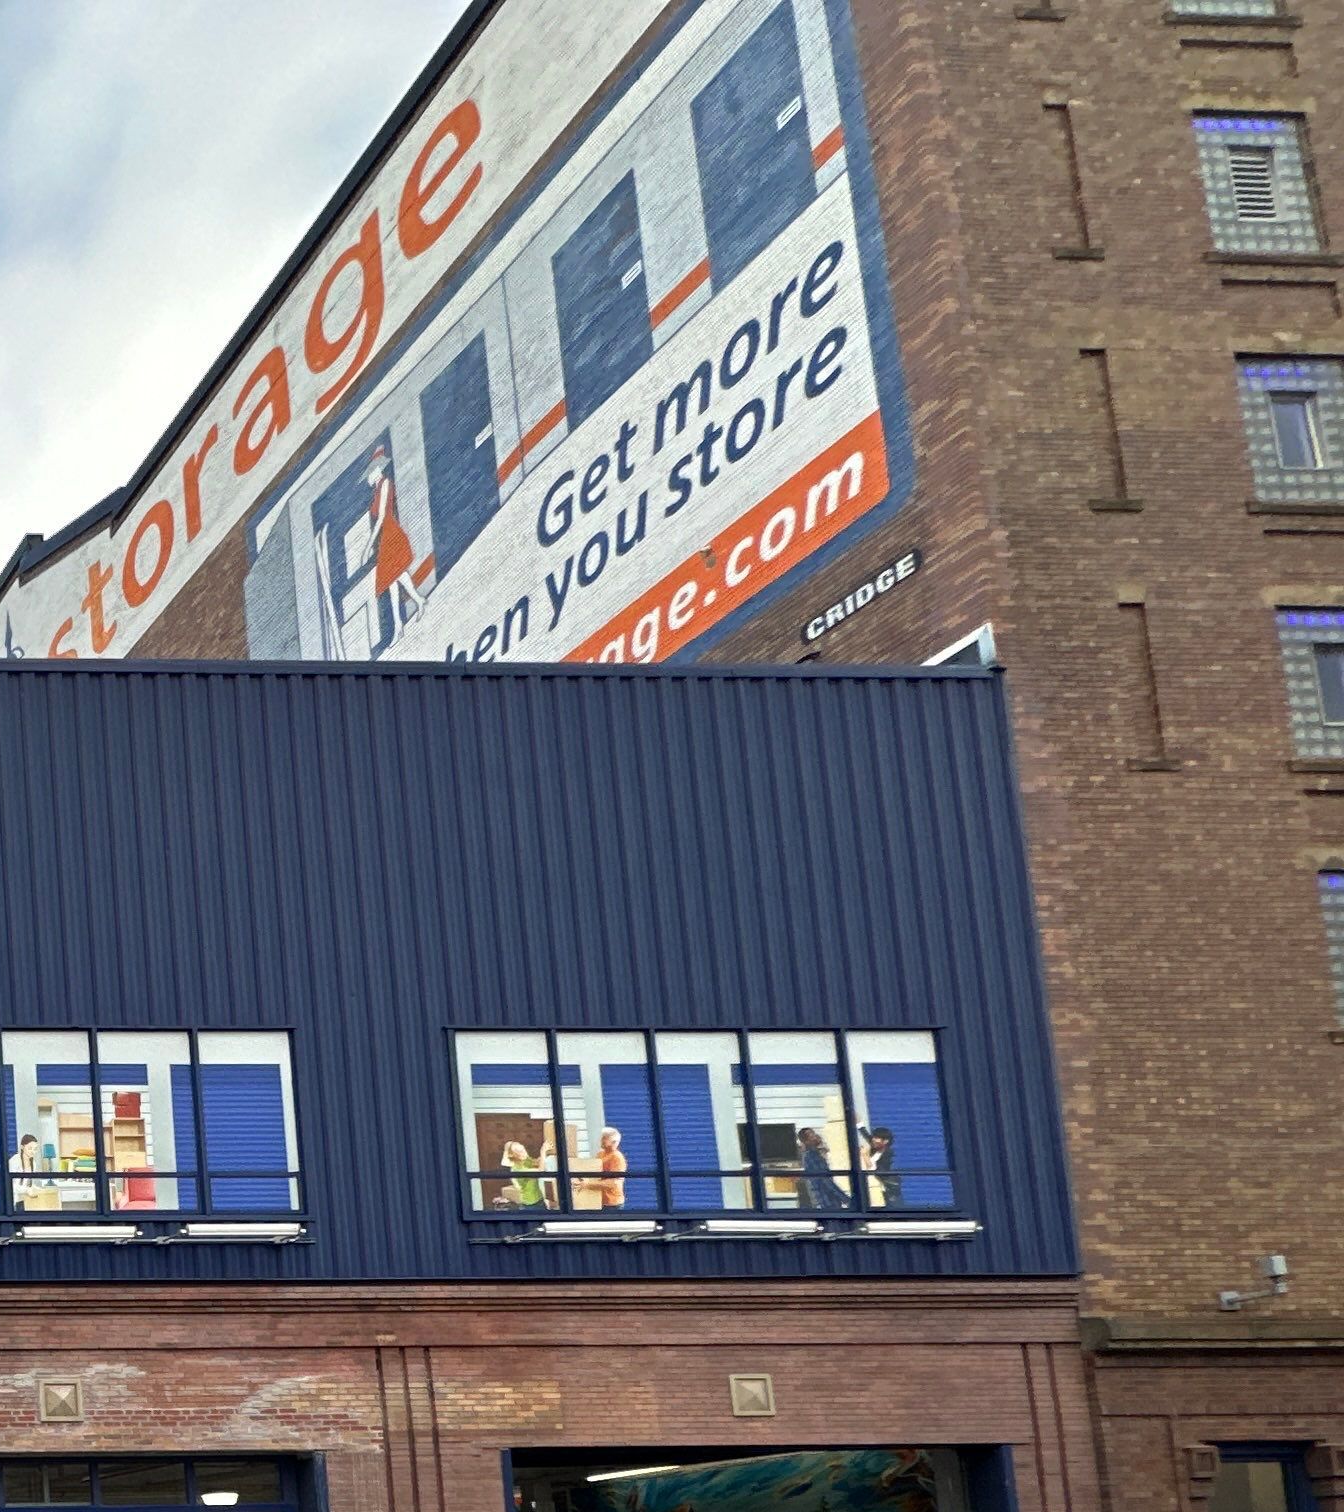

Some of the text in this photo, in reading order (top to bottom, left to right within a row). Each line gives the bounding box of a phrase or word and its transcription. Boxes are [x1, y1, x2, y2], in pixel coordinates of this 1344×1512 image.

[537, 240, 844, 548] Get more
[545, 489, 649, 633] you
[664, 326, 848, 519] store
[806, 551, 917, 641] CRIDGE
